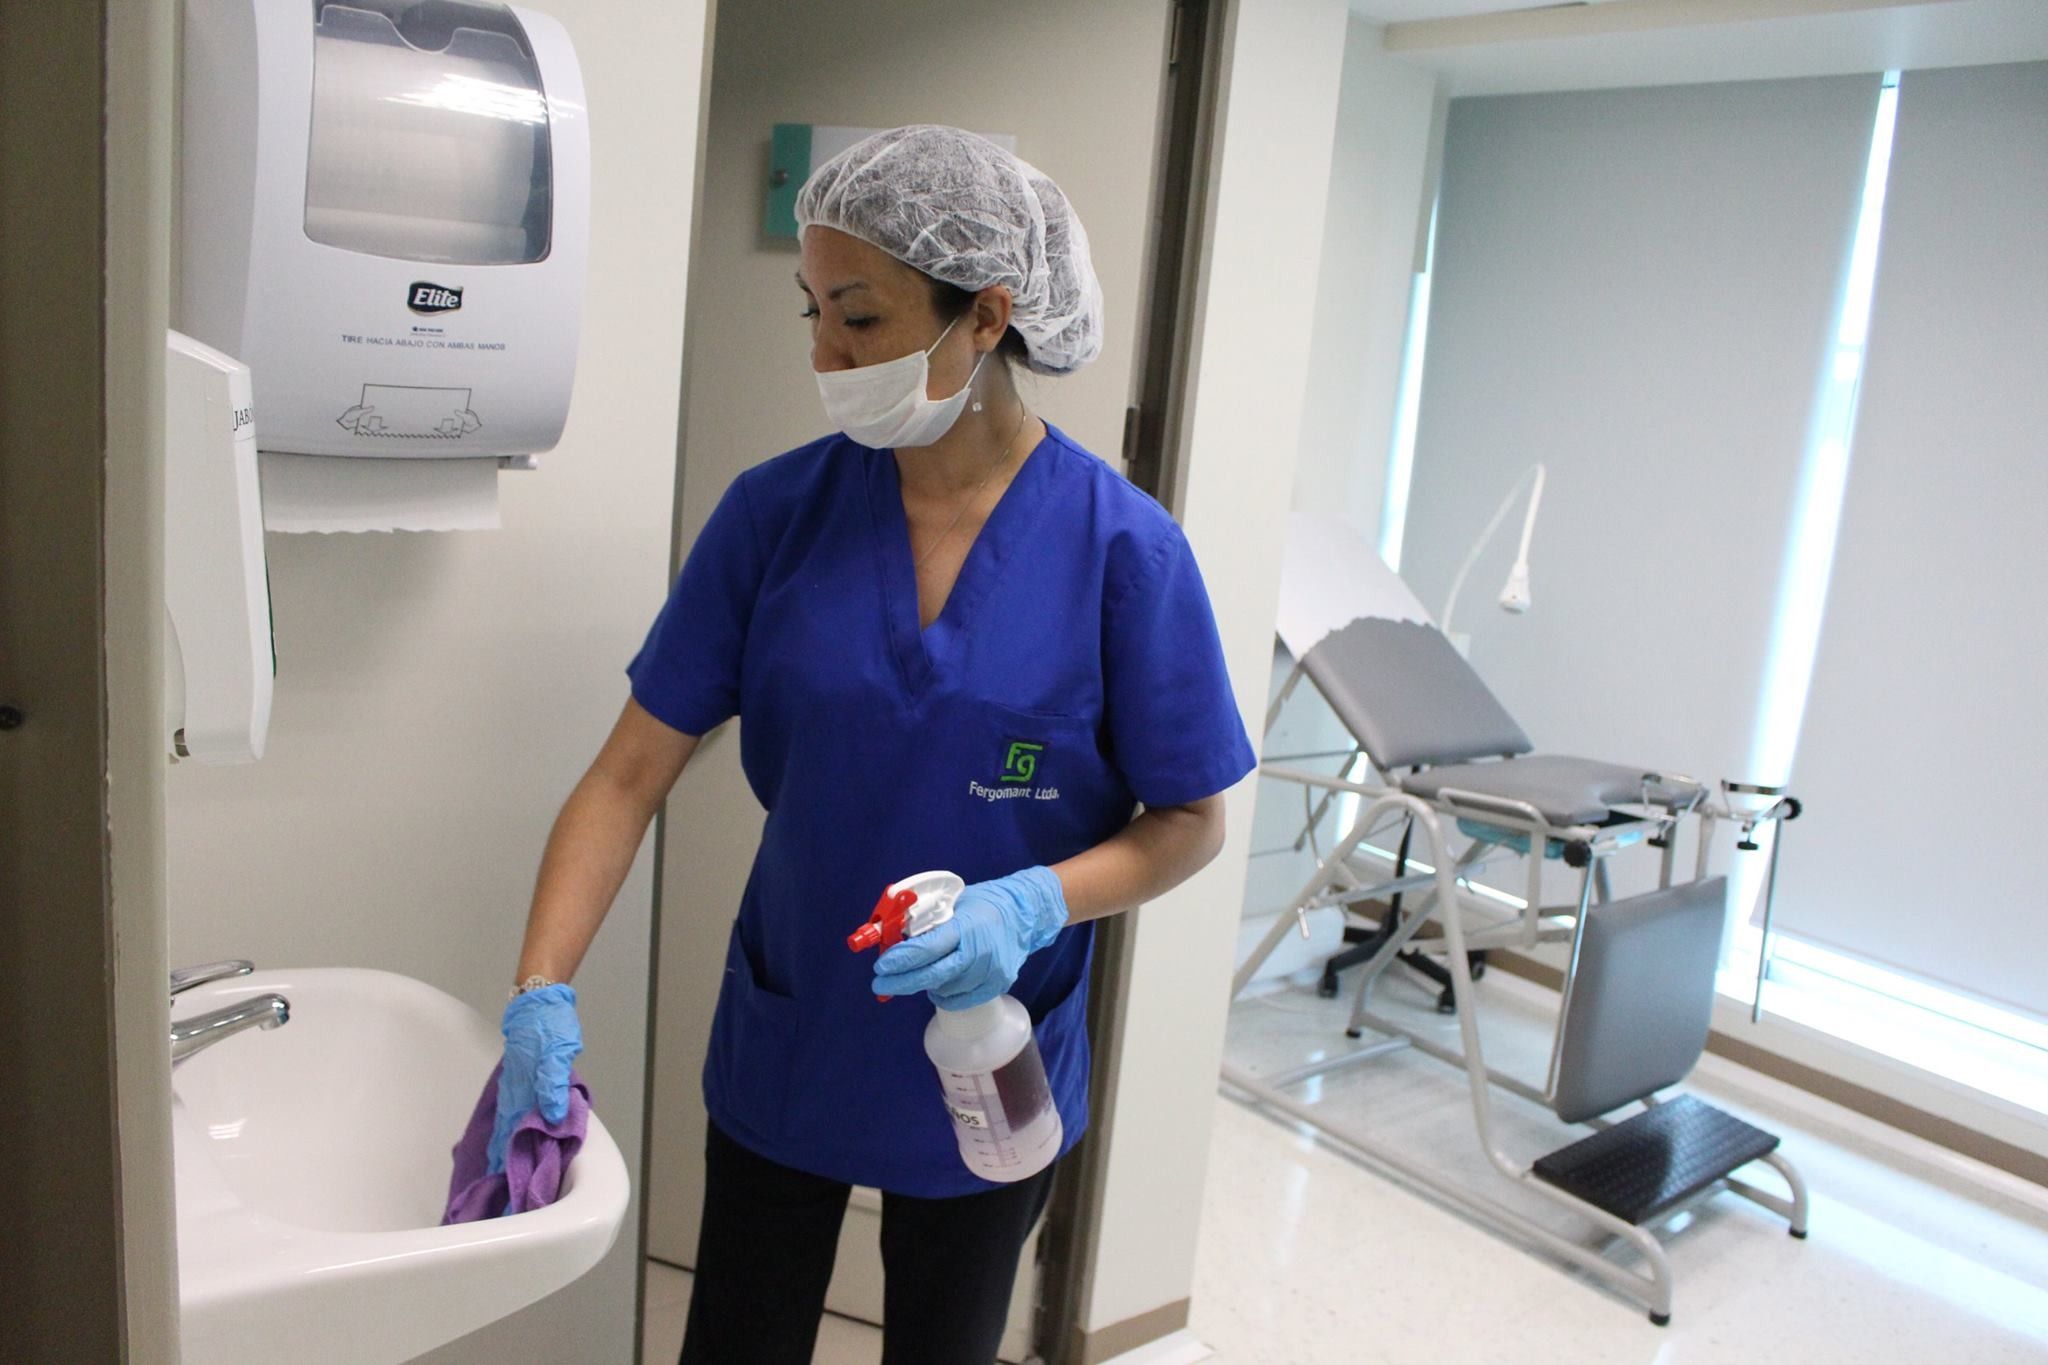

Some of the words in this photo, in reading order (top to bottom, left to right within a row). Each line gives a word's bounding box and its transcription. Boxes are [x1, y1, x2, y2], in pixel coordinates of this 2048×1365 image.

[413, 287, 459, 308] Elite
[342, 334, 363, 345] TIRE
[366, 335, 393, 345] HACIA
[395, 338, 424, 348] ABAJO
[426, 340, 446, 349] CON
[447, 341, 475, 350] AMBAS
[477, 342, 506, 351] MANOS
[969, 781, 1031, 802] Fergomant
[1034, 787, 1060, 800] Ltda.
